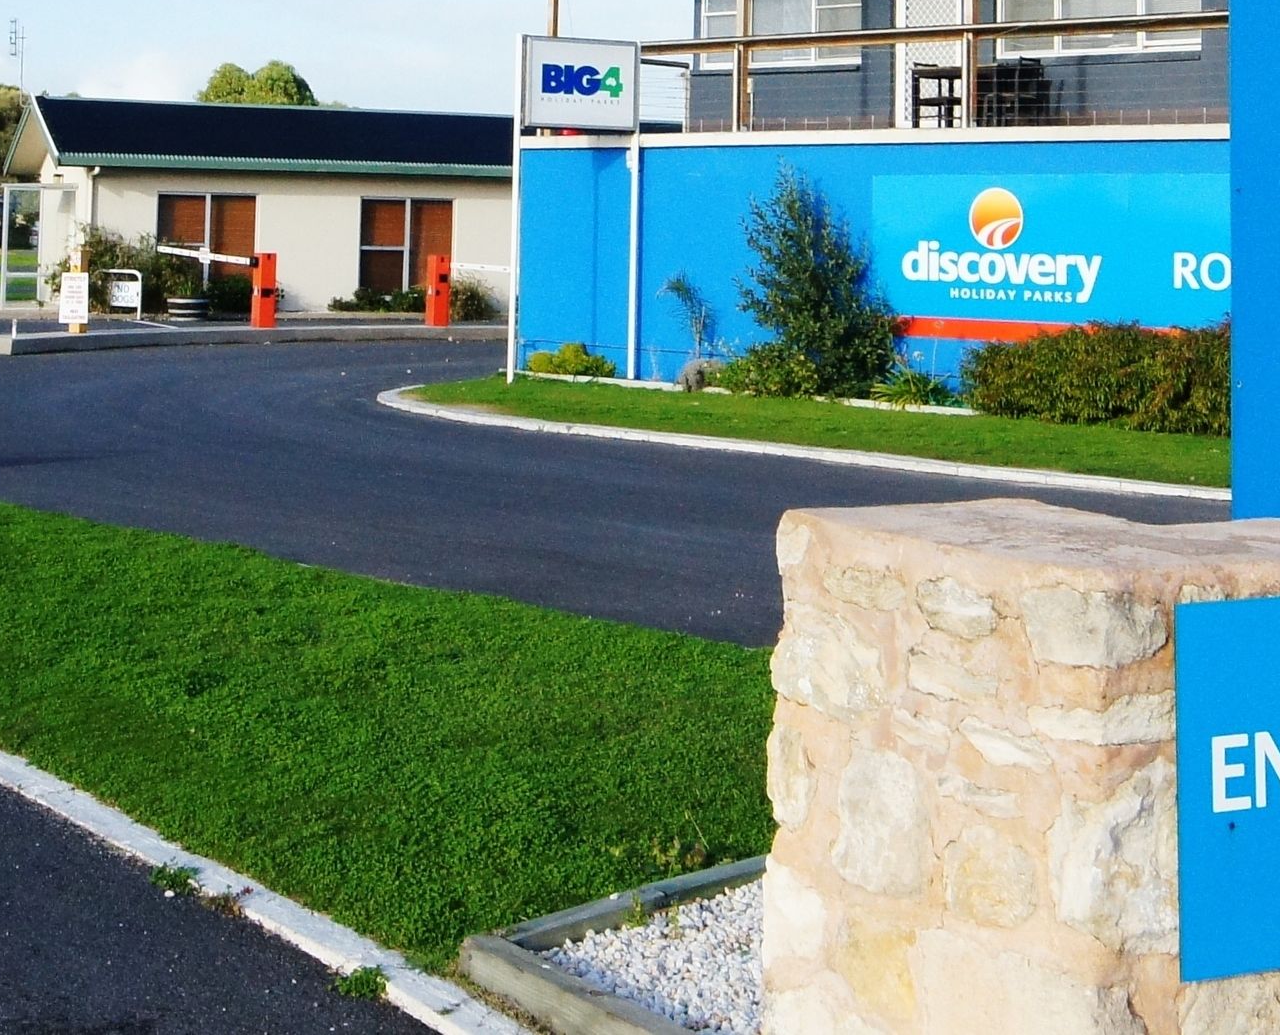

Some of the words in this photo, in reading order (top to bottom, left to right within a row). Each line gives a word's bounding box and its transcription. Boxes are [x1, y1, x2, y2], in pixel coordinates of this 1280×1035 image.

[541, 63, 623, 98] BIG4
[901, 240, 1102, 303] discovery
[1173, 252, 1231, 292] RO
[949, 287, 1017, 300] HOLIDAY
[1023, 289, 1073, 303] PARKS
